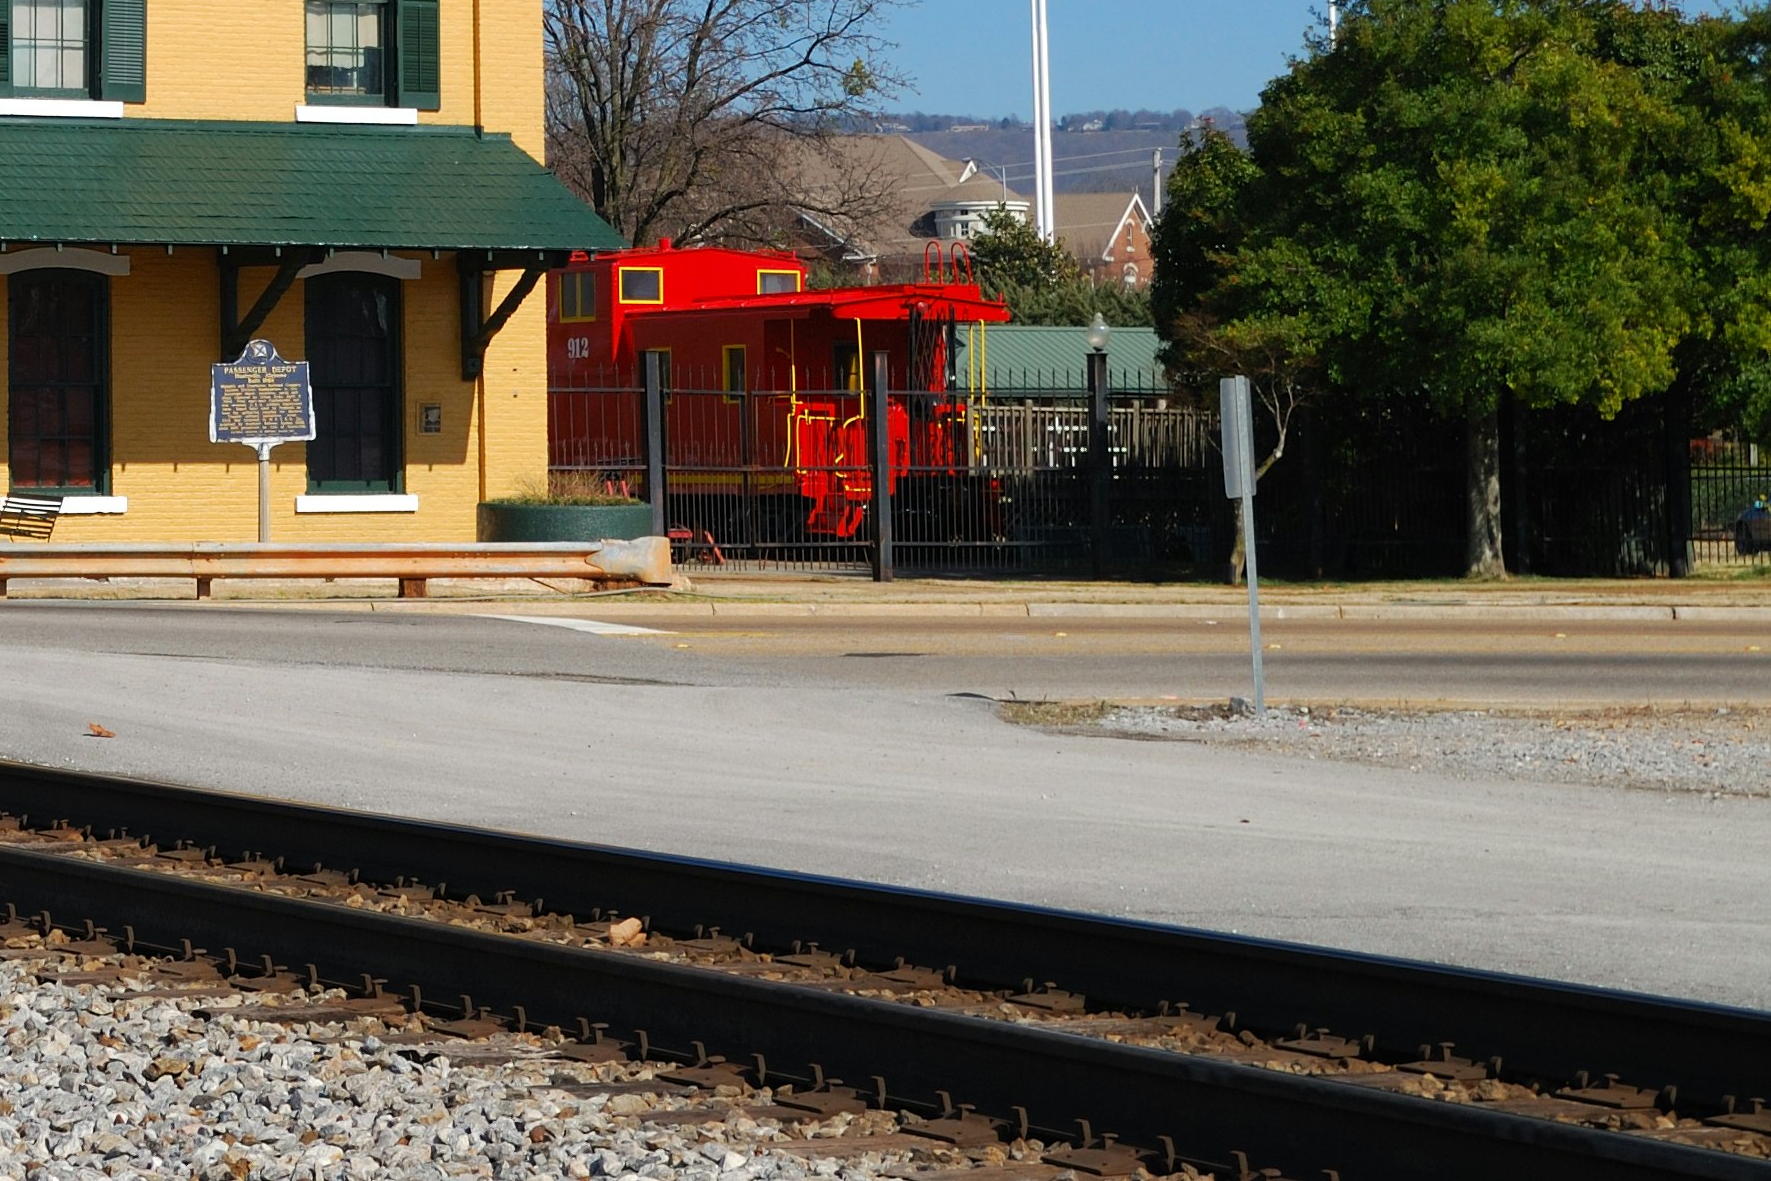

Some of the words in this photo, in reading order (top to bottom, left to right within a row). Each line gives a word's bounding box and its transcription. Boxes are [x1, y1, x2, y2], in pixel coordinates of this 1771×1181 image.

[567, 337, 589, 359] 912
[224, 366, 267, 374] PASSENGER
[271, 365, 297, 373] DEPOT
